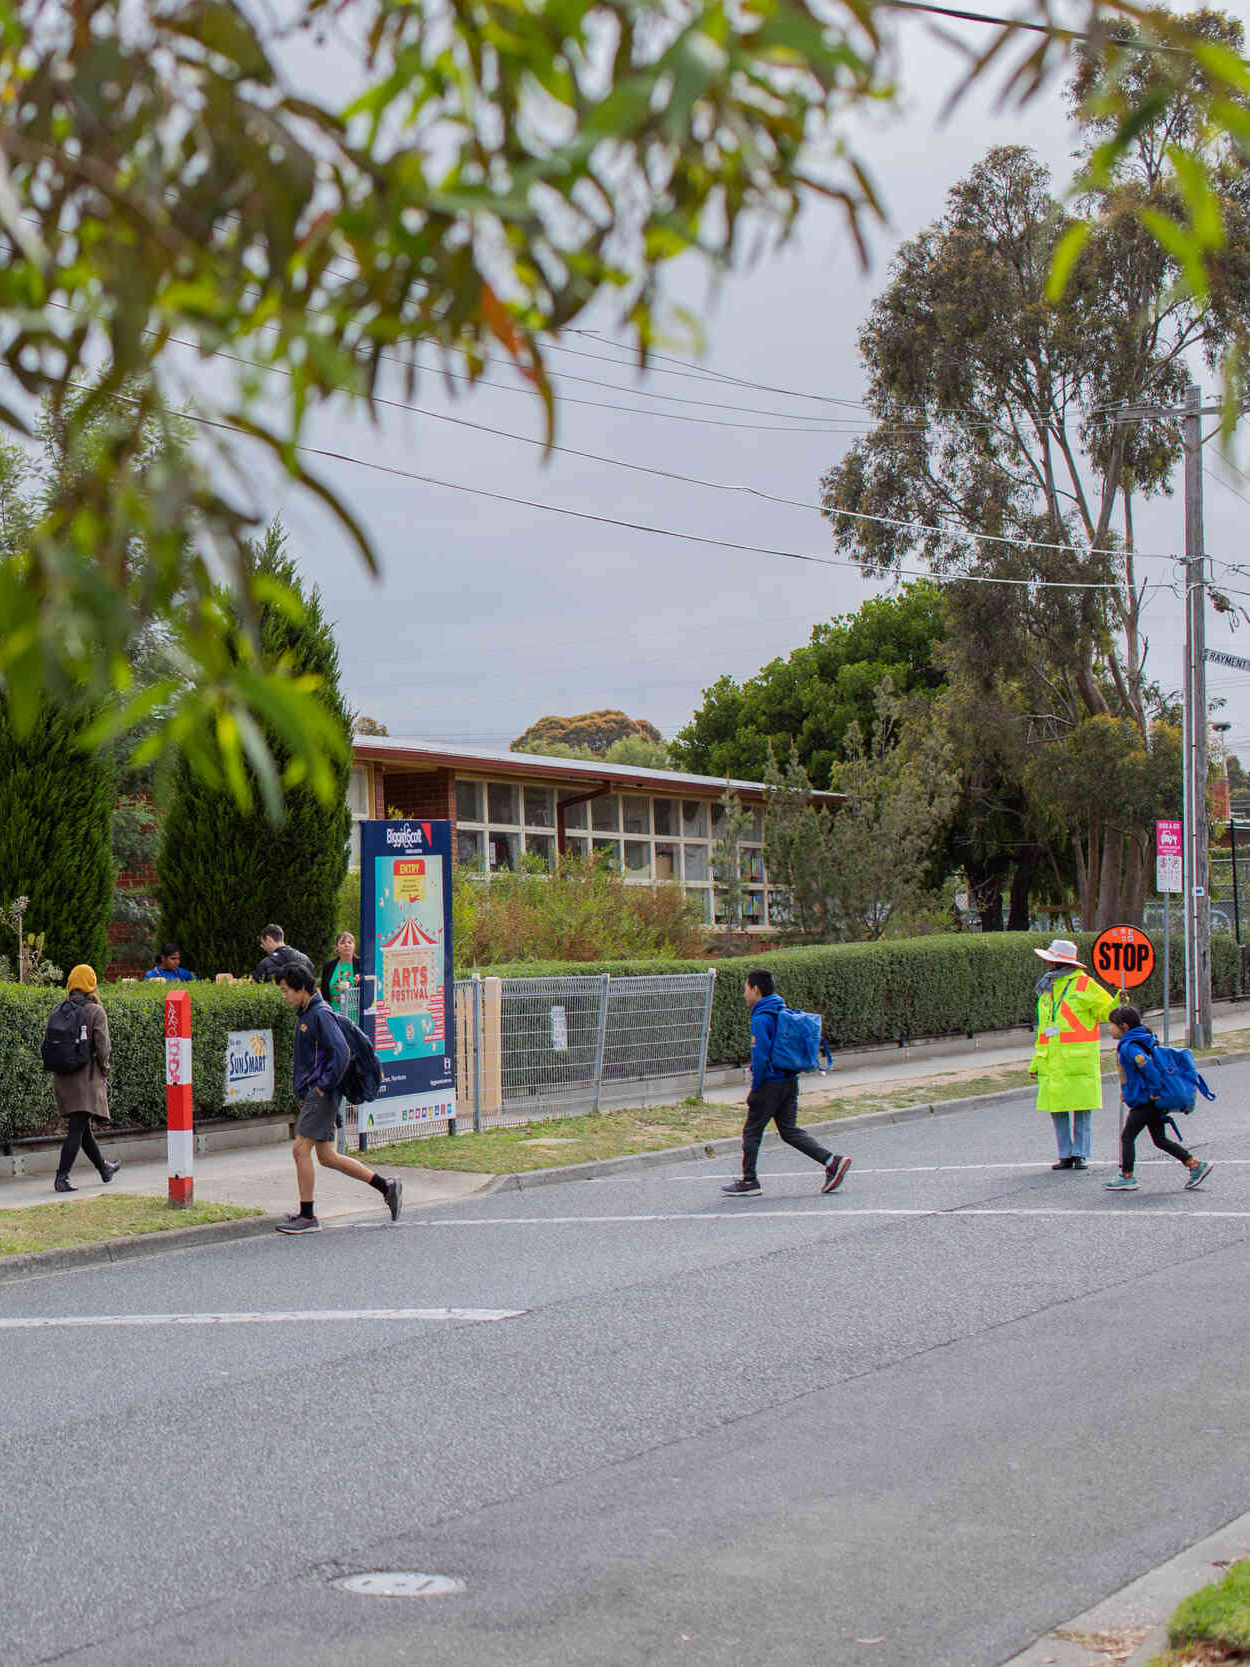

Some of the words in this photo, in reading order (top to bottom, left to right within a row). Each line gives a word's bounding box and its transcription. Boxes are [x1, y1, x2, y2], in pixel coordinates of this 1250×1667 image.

[1209, 651, 1247, 671] RAYMENT
[399, 863, 421, 874] ENTRY
[1099, 941, 1150, 972] STOP
[391, 966, 428, 988] ARTS
[390, 987, 429, 1001] FESTIVAL
